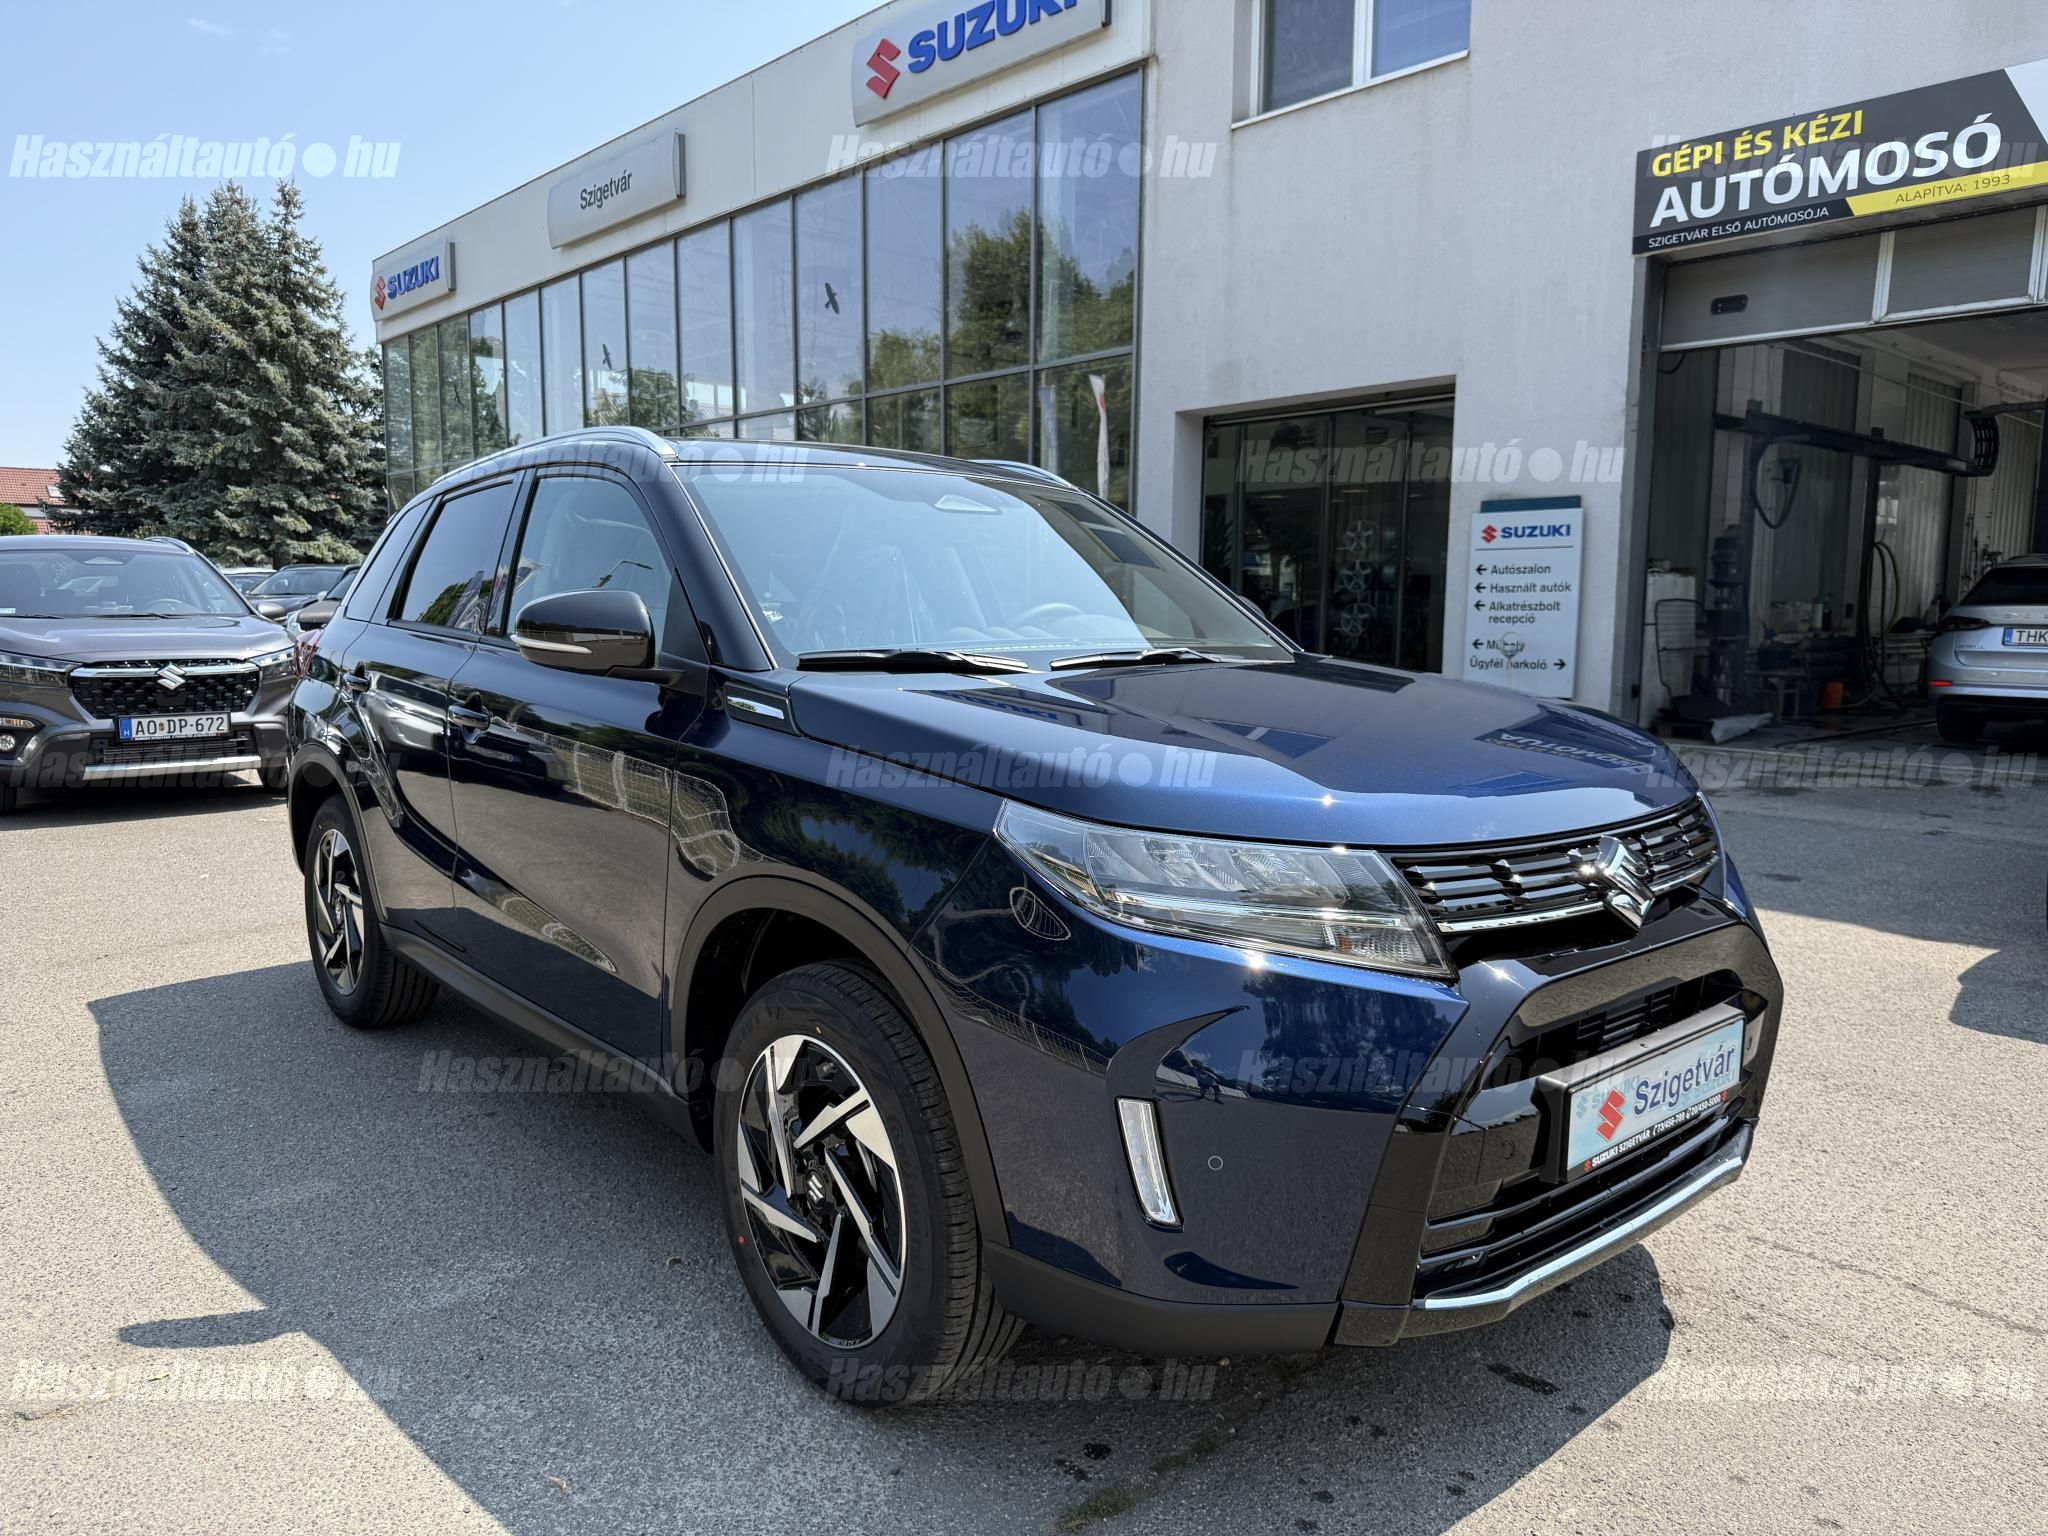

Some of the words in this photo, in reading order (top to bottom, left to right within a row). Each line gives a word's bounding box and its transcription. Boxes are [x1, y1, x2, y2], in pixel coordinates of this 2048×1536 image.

[908, 0, 1077, 73] SUZUK
[1652, 141, 1722, 177] GÉPI
[1734, 130, 1773, 160] ÉS
[1783, 109, 1863, 150] KÉZI
[1650, 112, 2001, 228] AUTÓMOSÓ
[580, 169, 632, 210] Szigetvár
[1895, 183, 1967, 204] ALAPÍTVA:
[1973, 174, 2010, 191] 1993
[1648, 227, 1709, 248] SZIGETVÁR
[1744, 206, 1829, 231] AUTÓMOSÓJA
[387, 256, 439, 300] SUZUKI
[1501, 524, 1571, 539] SUZUKI
[1490, 564, 1551, 576] Autószalon
[1490, 582, 1537, 594] Használt
[1539, 581, 1572, 593] autók
[1488, 600, 1561, 613] Alkatrészbolt
[1488, 613, 1536, 625] recepció
[1507, 658, 1548, 671] arkoló
[1634, 1044, 1735, 1115] Szigetvár
[1592, 1146, 1618, 1167] SUZUKI
